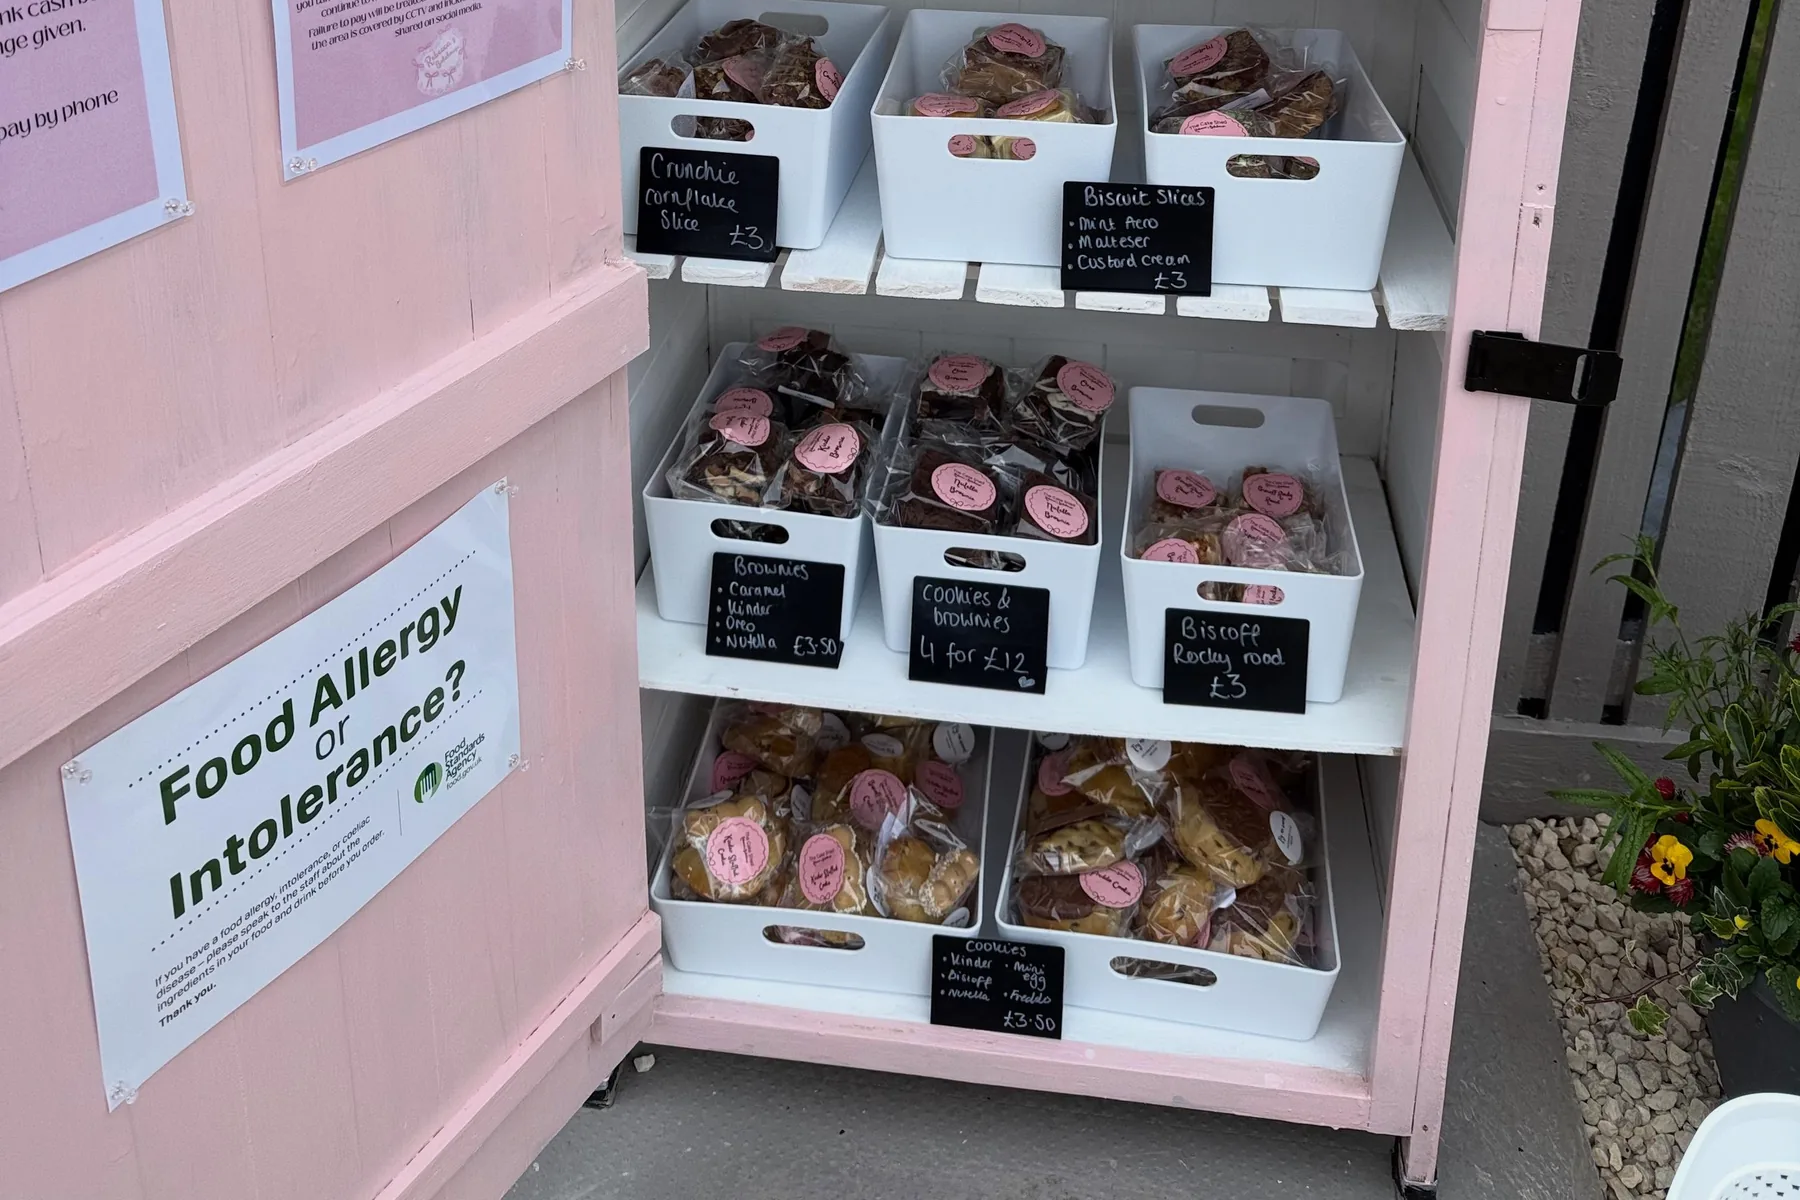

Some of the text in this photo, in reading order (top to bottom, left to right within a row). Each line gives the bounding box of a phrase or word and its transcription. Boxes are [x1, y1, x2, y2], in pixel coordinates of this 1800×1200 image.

[296, 0, 314, 13] you
[33, 19, 86, 50] given.
[395, 21, 423, 37] shared
[424, 18, 434, 27] on
[436, 9, 458, 23] social
[35, 109, 58, 129] by
[62, 89, 119, 122] phone
[651, 153, 739, 185] Crunchie
[1084, 185, 1206, 206] Biscuit Slices
[1125, 216, 1159, 229] Aero
[729, 224, 764, 250] £3
[1078, 235, 1151, 249] Malteser
[1077, 253, 1137, 270] Custard
[1154, 271, 1188, 289] £3
[734, 555, 809, 580] Brownies
[729, 581, 785, 598] Caramel
[998, 587, 1011, 609] &
[728, 599, 772, 616] Kinder
[725, 615, 756, 632] Oreo
[1182, 616, 1260, 647] Biscoff
[726, 634, 777, 649] Nutella
[920, 635, 1029, 673] 4 for £12
[1173, 643, 1232, 674] Rocky
[1209, 674, 1246, 699] £3
[159, 584, 462, 825] Food Allergy
[315, 715, 349, 760] or
[445, 737, 466, 762] Food
[445, 733, 485, 771] Standards
[446, 749, 476, 781] Agency
[170, 659, 465, 919] Intolerance?
[155, 816, 370, 987] If you have a food allergy, intolerance, or coeliac
[156, 837, 360, 999] disease please speak to the staff about the
[157, 830, 384, 1012] ingredients in your food and drink before you order.
[951, 952, 992, 969] Kinder
[966, 940, 1026, 957] Cookies
[1023, 973, 1046, 992] egg
[159, 983, 216, 1027] Thank you.
[948, 989, 1051, 1004] Nutella Freddo
